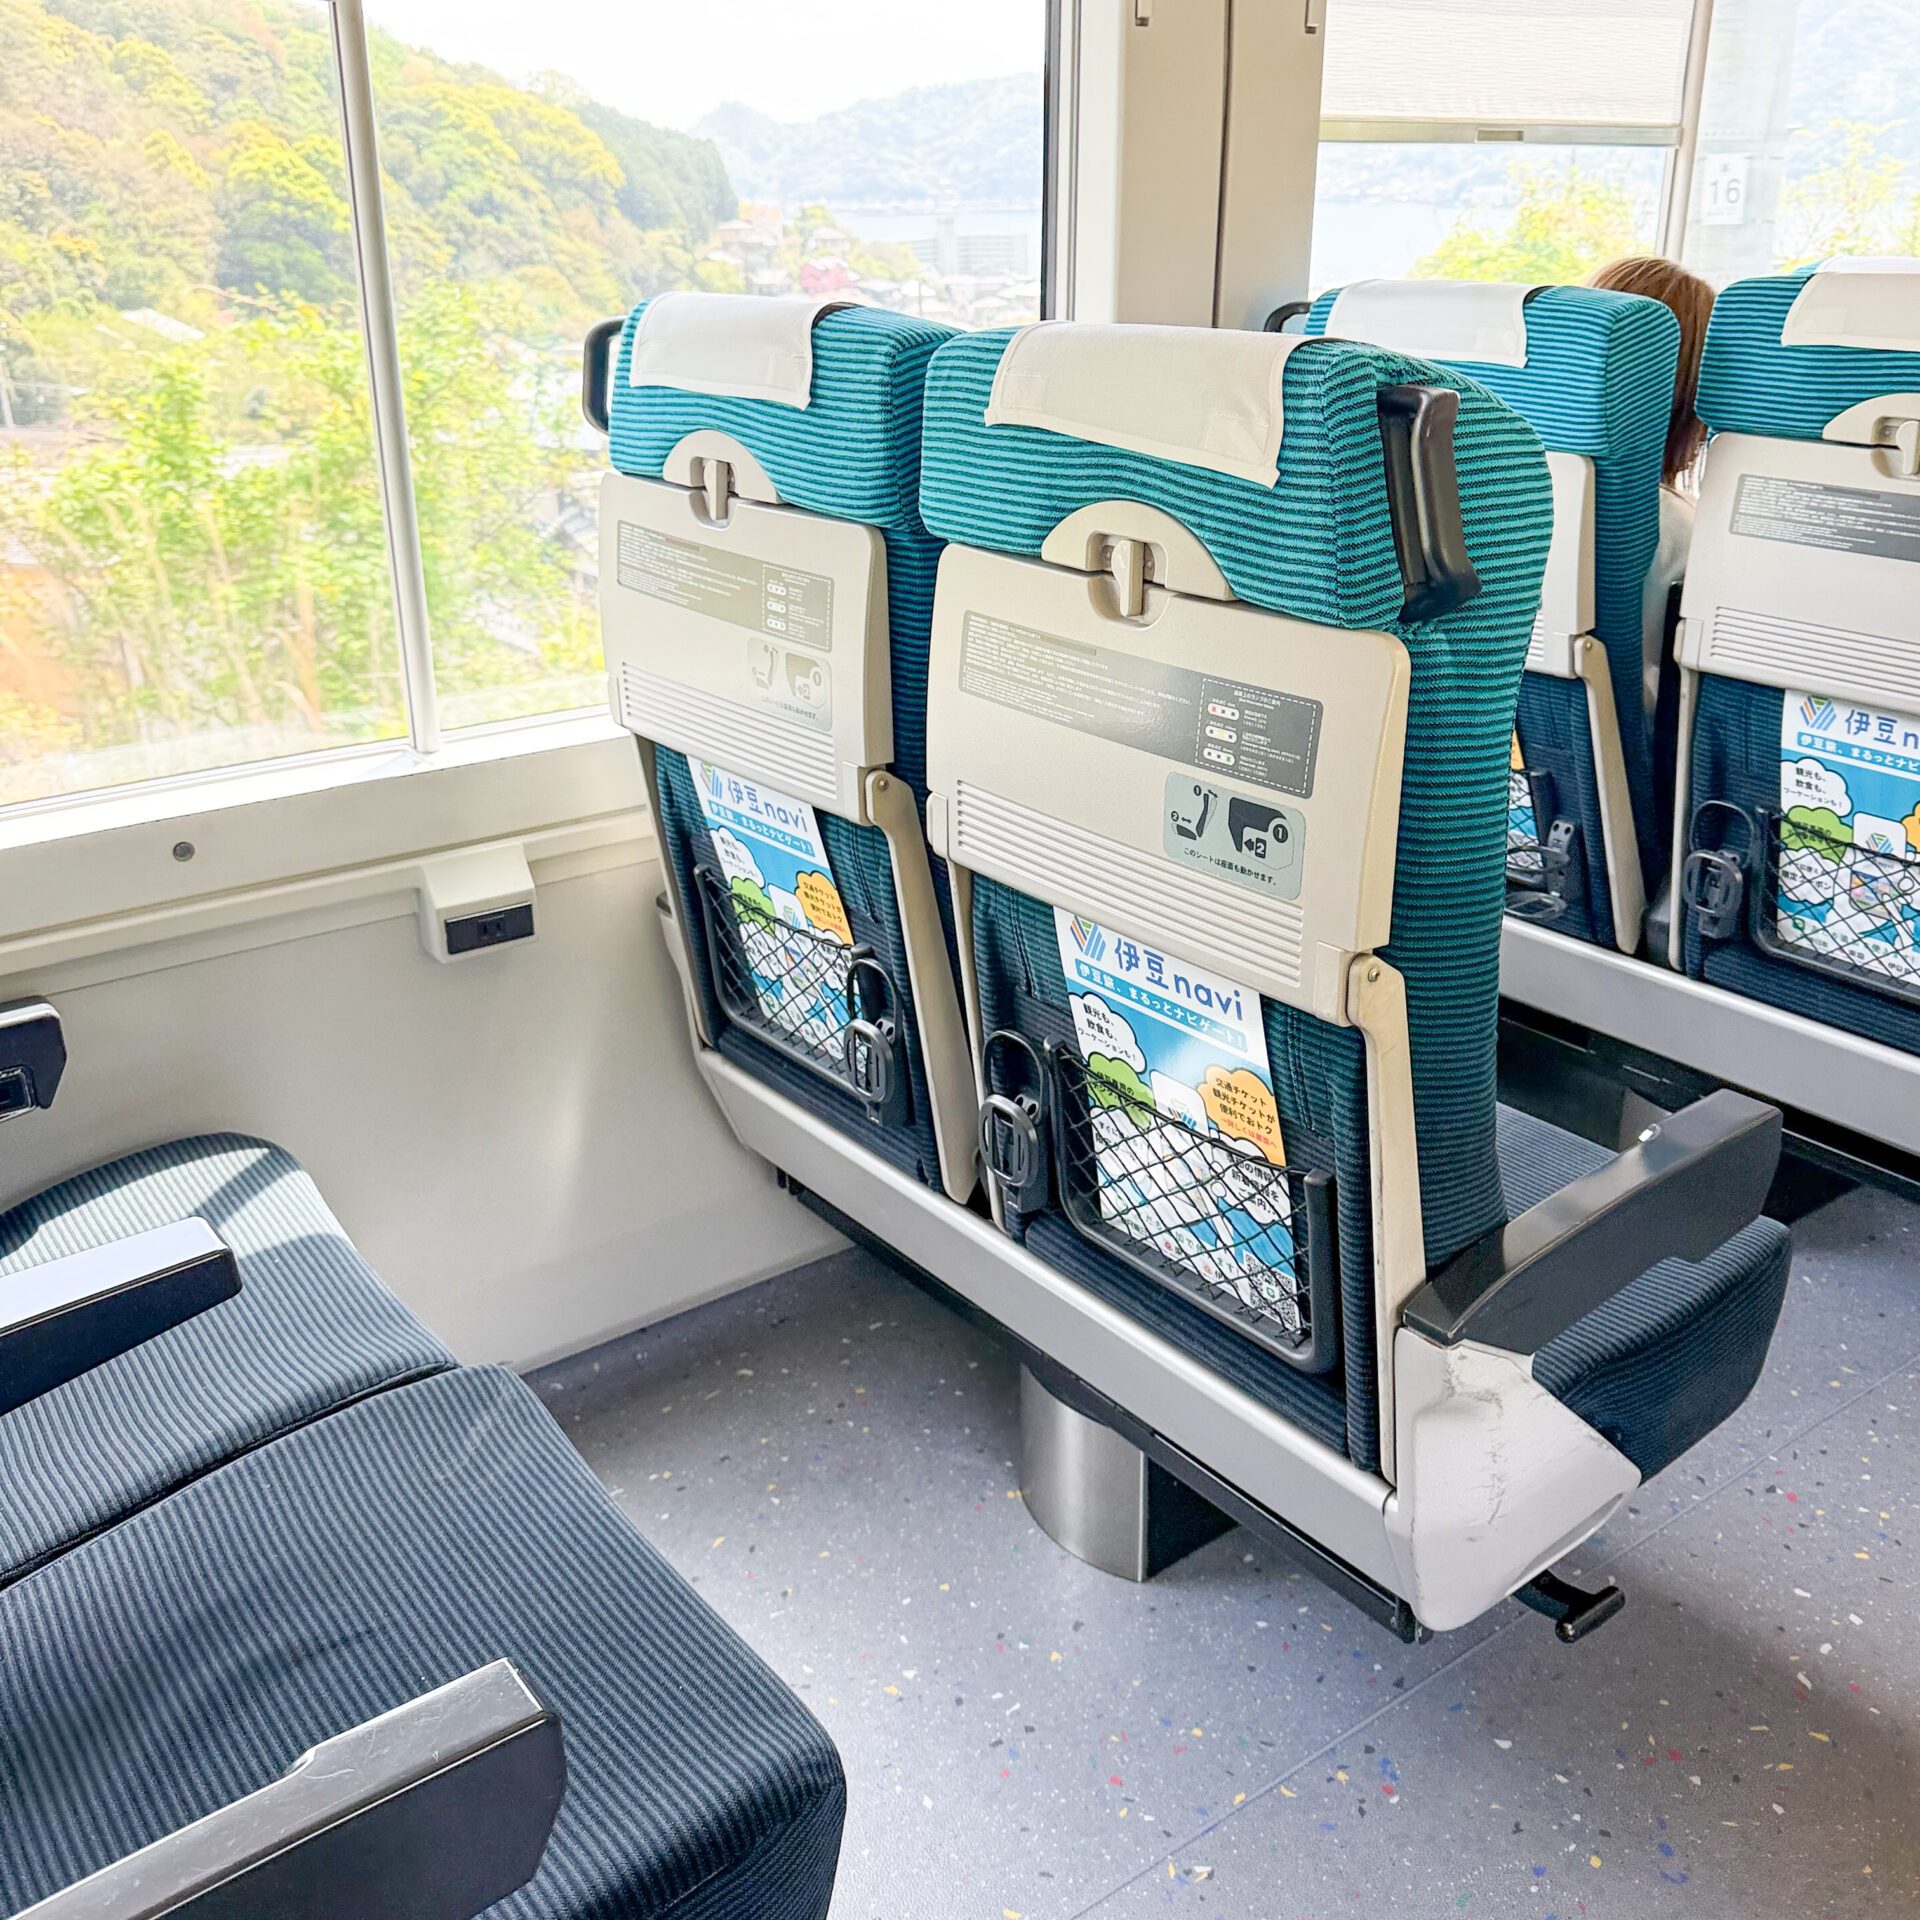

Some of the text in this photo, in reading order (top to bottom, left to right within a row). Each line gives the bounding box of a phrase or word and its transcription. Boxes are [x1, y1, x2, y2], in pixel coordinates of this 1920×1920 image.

[1710, 178, 1741, 205] 16
[727, 776, 808, 832] 伊豆navi
[1183, 846, 1278, 886] このシートは座面も動かせます。
[1114, 937, 1244, 1021] 伊豆navi
[1079, 963, 1243, 1047] 伊豆旅、まるっとナビゲート！
[1083, 1003, 1114, 1026] 観光も、
[1087, 1018, 1118, 1041] 飲食も、
[1212, 1088, 1275, 1124] 観光チケットが
[1216, 1077, 1267, 1106] 交通チケット
[1220, 1104, 1273, 1135] 便利でおトク
